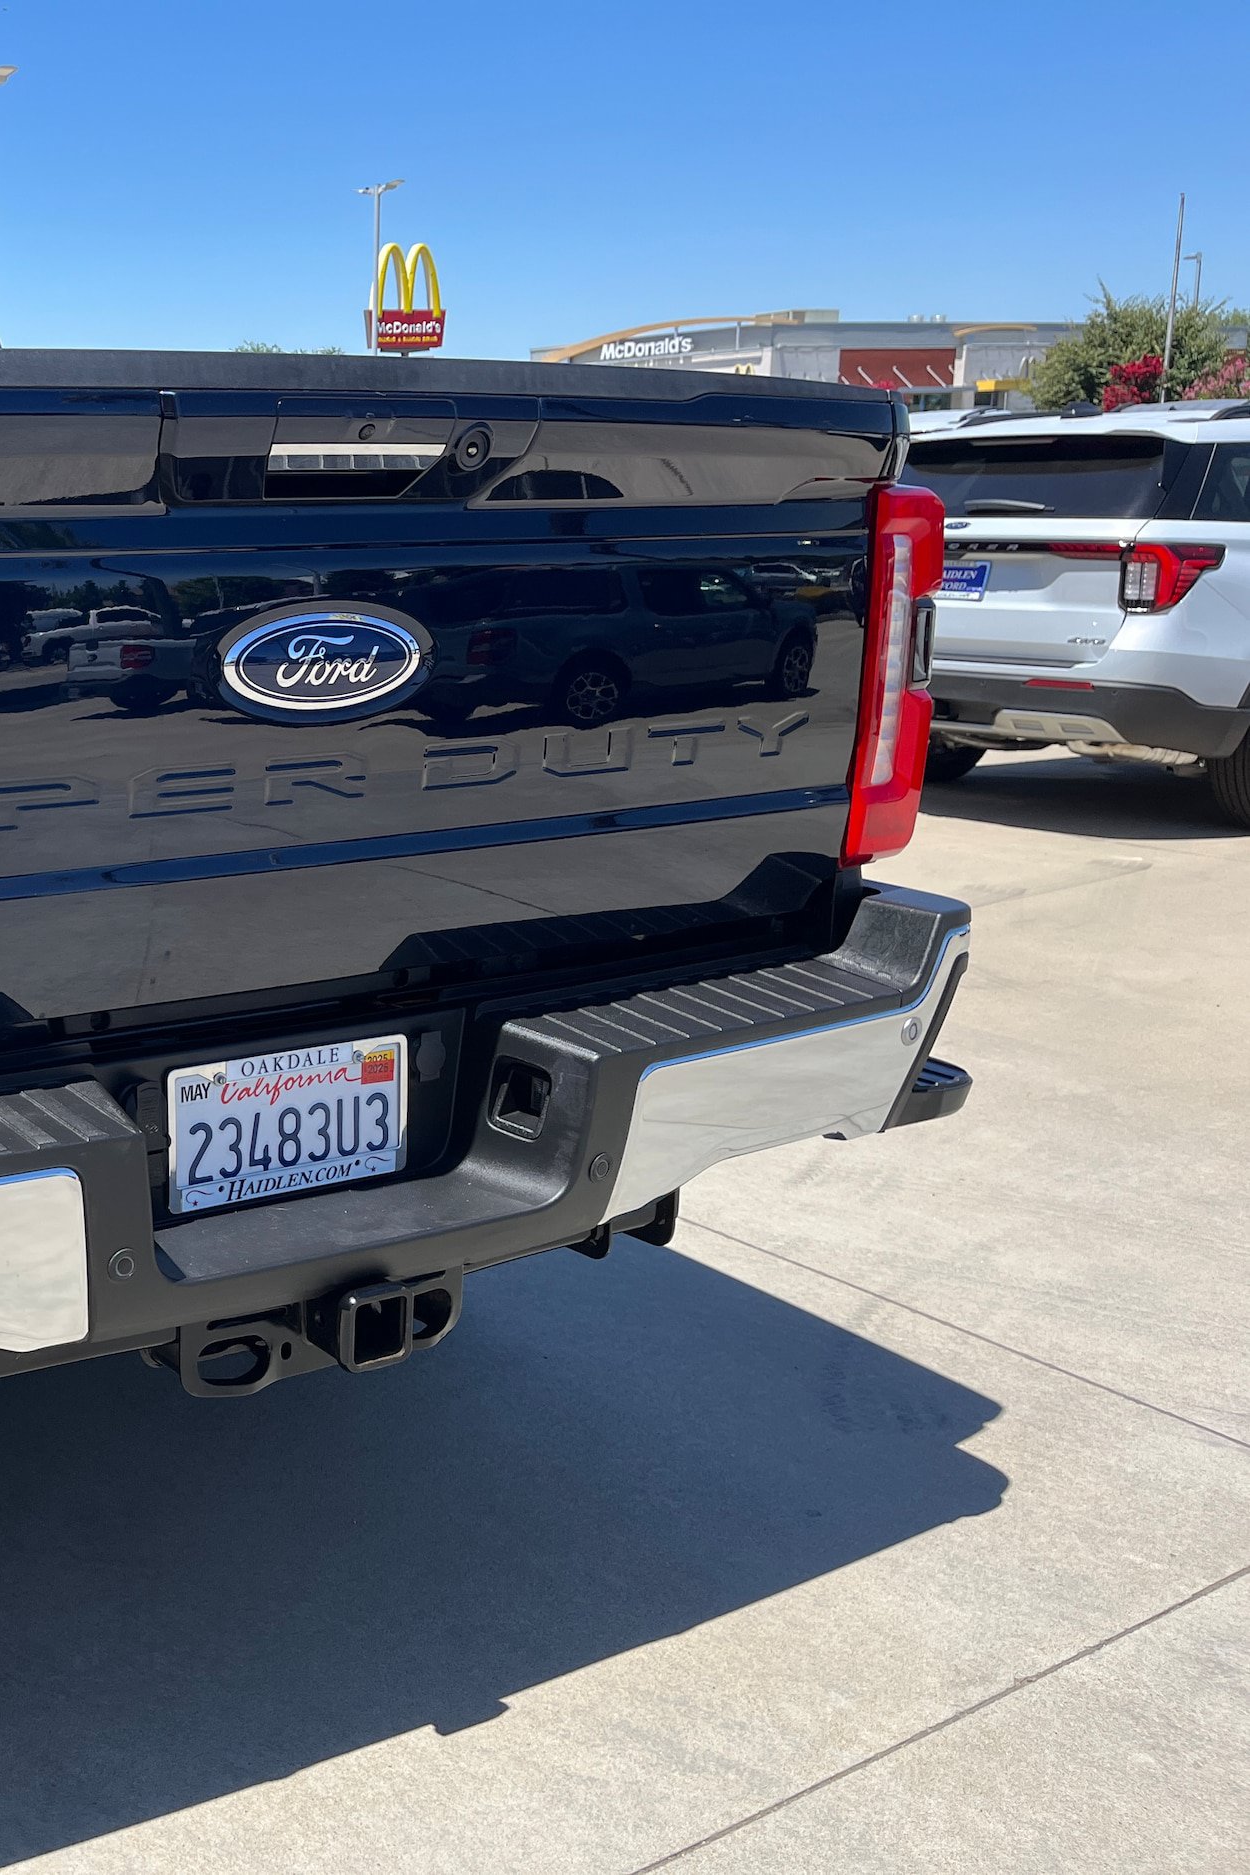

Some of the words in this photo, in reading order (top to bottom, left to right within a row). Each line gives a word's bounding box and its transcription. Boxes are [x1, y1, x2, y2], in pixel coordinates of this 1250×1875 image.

[377, 321, 441, 333] McDonald's
[600, 336, 692, 360] McDonald's
[943, 570, 978, 579] AIDLEN
[276, 634, 380, 688] Ford
[422, 709, 811, 792] DUTY
[241, 1047, 340, 1077] OAKDALE
[181, 1082, 211, 1103] MAY
[220, 1066, 362, 1105] California
[367, 1063, 389, 1074] 2026
[188, 1092, 390, 1186] 23483U3
[225, 1162, 354, 1202] HAIDLEN.COM
